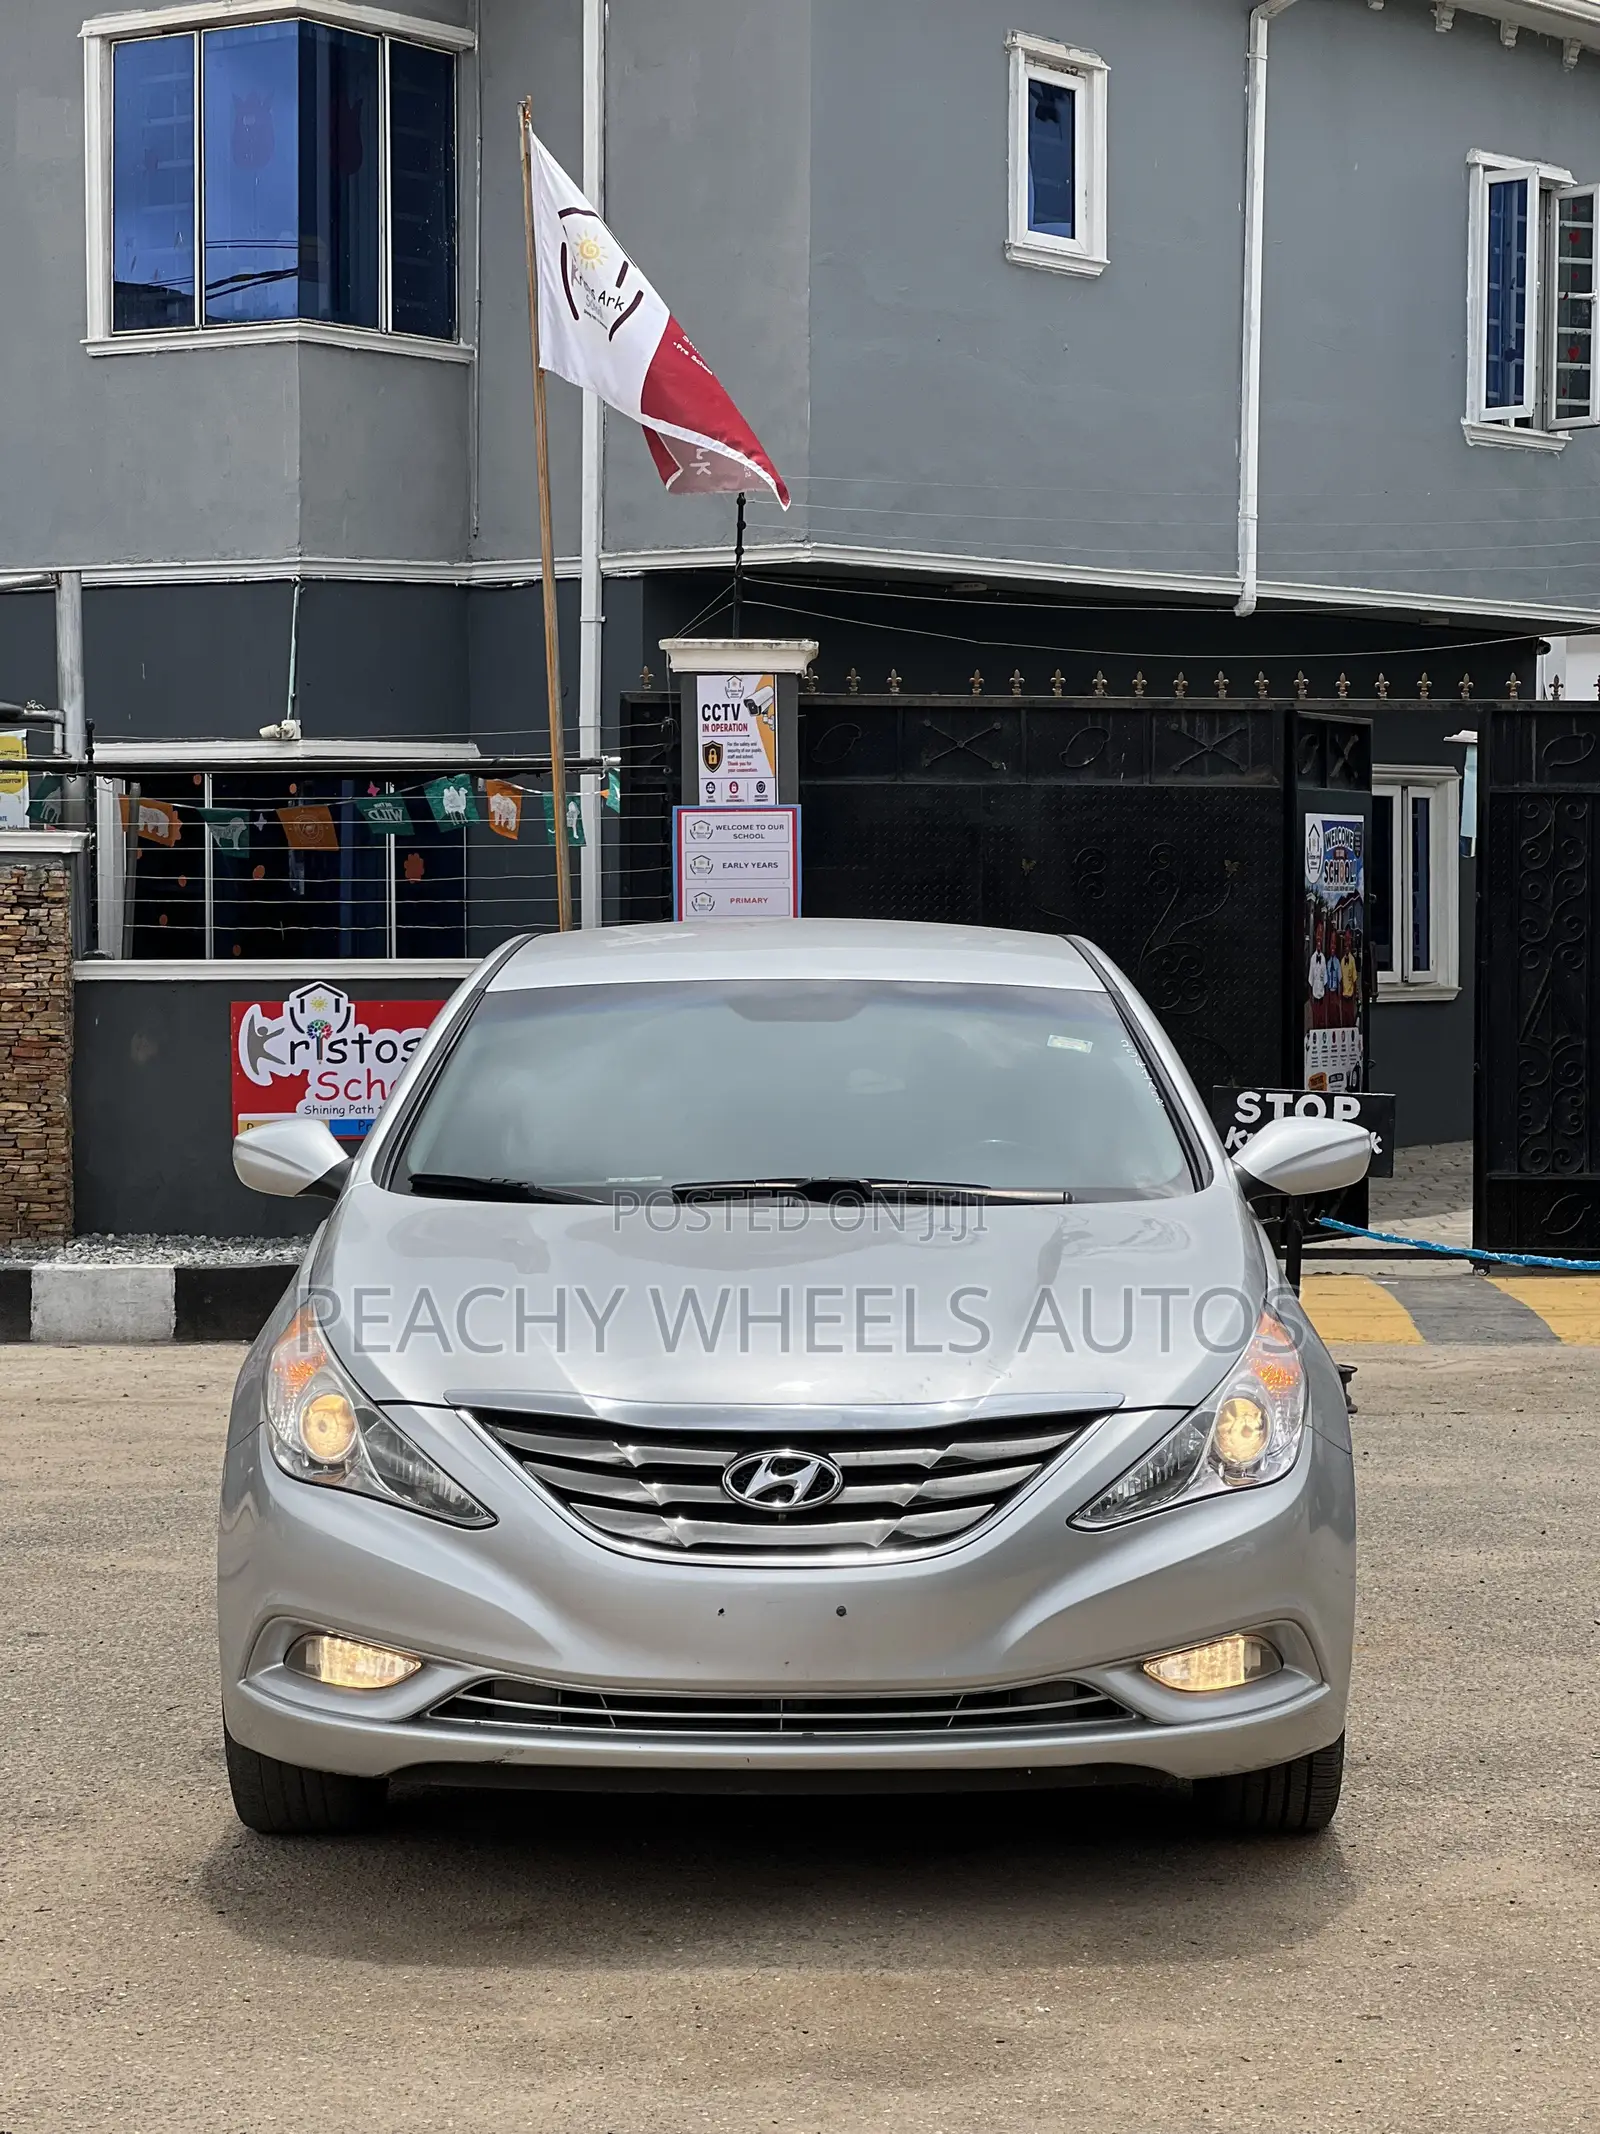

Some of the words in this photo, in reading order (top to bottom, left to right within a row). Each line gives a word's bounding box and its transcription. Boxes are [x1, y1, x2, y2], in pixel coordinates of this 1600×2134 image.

[598, 290, 624, 311] Ark
[702, 703, 741, 722] CCTV
[702, 723, 710, 733] IN
[711, 723, 748, 733] OPERATION
[1324, 826, 1354, 851] WELCOME
[751, 861, 779, 869] YEARS
[314, 1068, 398, 1102] Sch
[304, 1104, 346, 1118] Shining
[349, 1104, 375, 1115] Path
[1234, 1091, 1361, 1124] STOP
